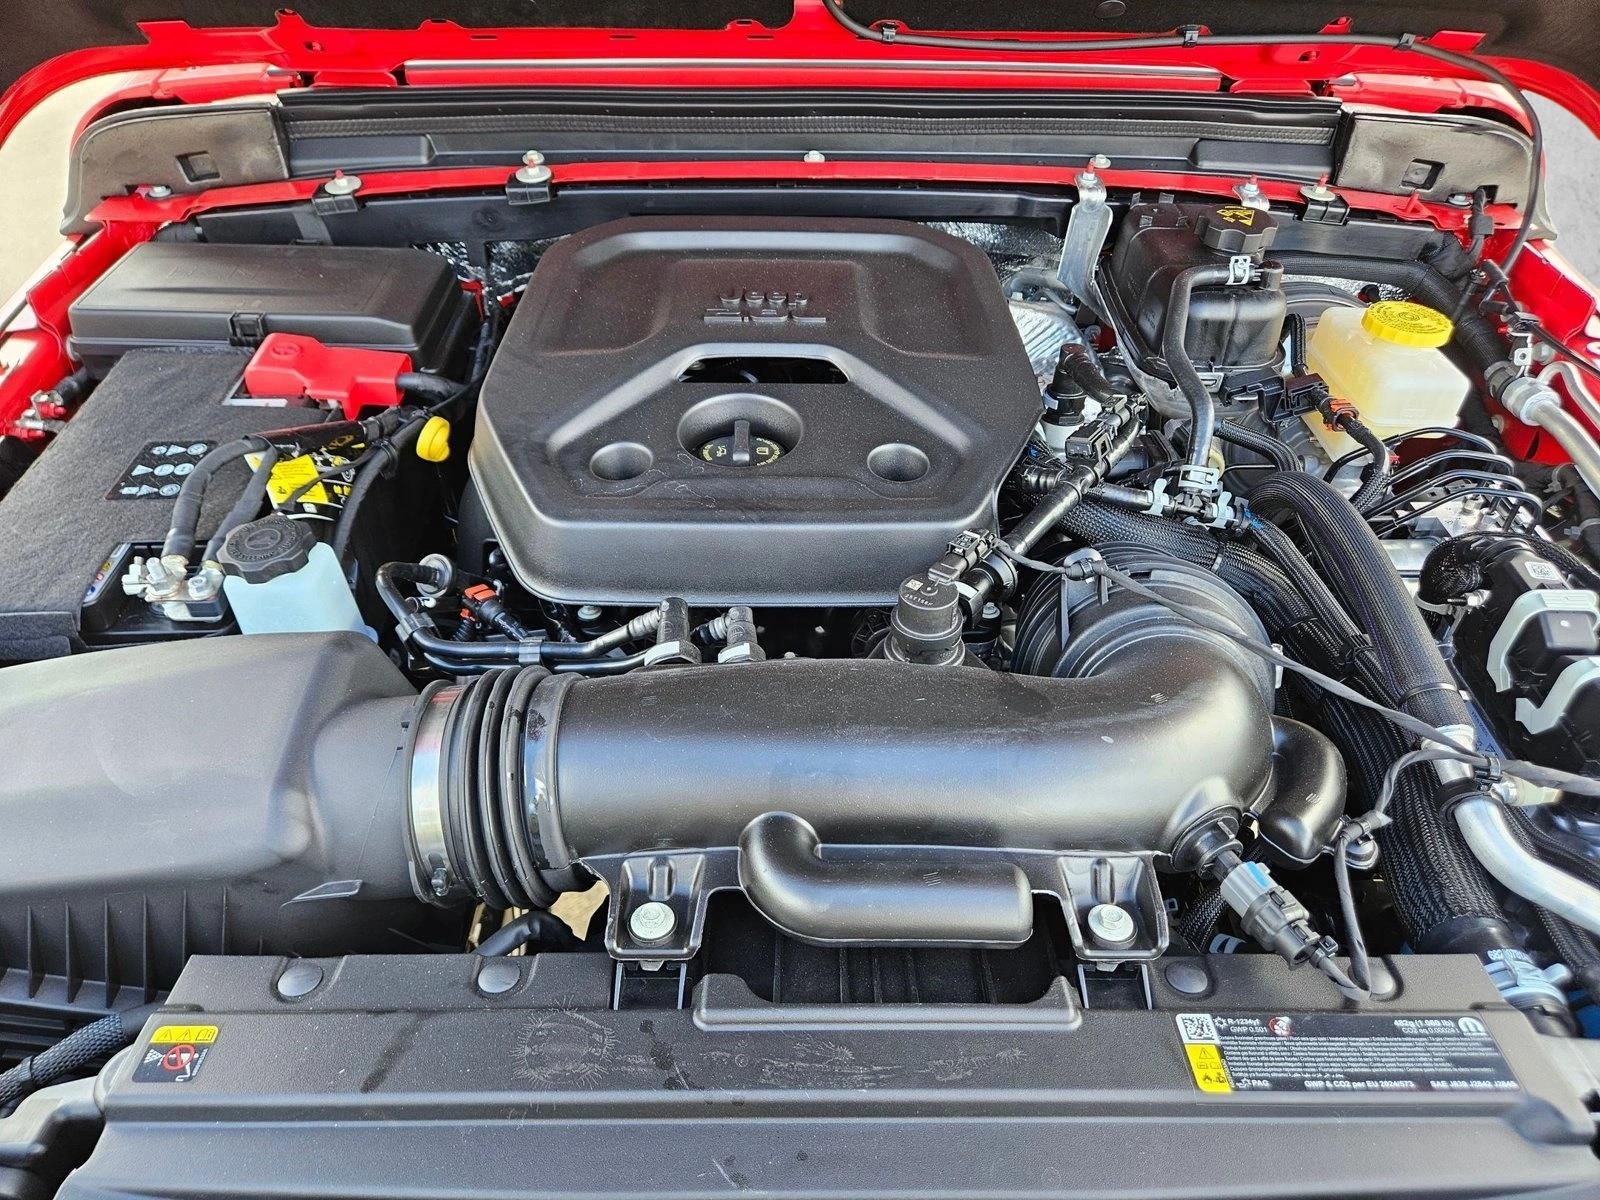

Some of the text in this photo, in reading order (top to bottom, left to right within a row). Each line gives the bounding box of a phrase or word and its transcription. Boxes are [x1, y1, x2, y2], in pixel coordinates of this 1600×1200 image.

[718, 289, 809, 309] Jeep
[1227, 1018, 1260, 1026] R-1234yf
[1251, 1079, 1270, 1087] PAG
[1304, 1080, 1325, 1088] GWP
[1325, 1080, 1333, 1088] &
[1333, 1080, 1351, 1088] CO2
[1352, 1081, 1366, 1089] per
[1366, 1080, 1379, 1088] EU
[1429, 1080, 1448, 1088] SAE
